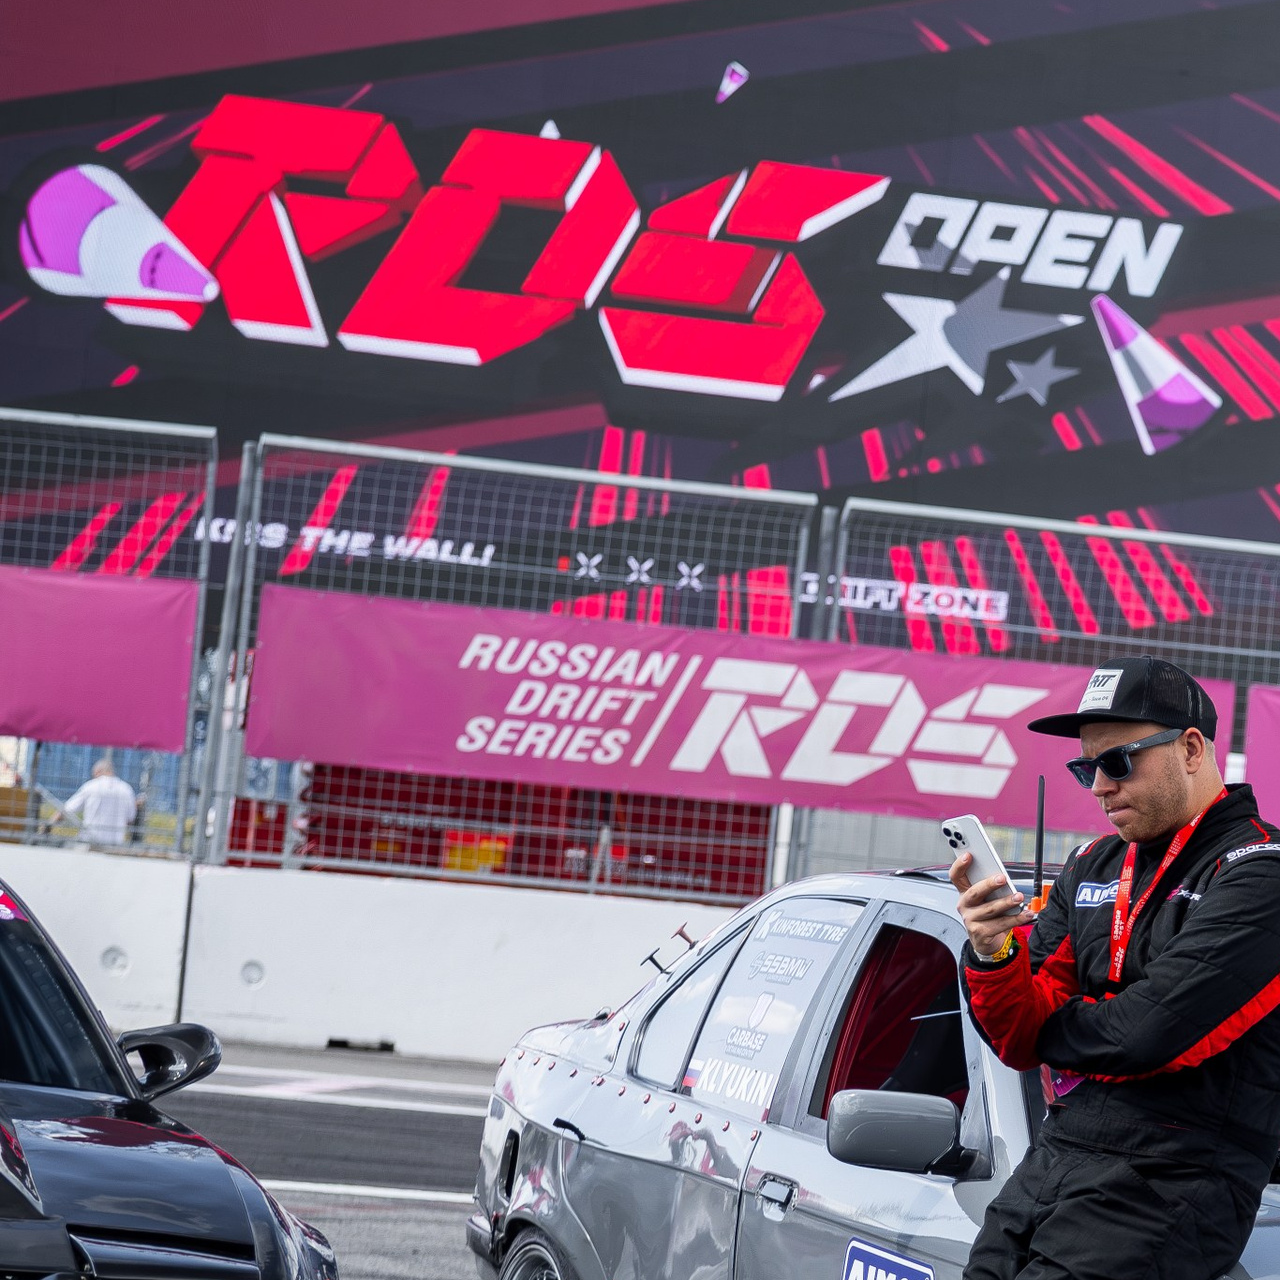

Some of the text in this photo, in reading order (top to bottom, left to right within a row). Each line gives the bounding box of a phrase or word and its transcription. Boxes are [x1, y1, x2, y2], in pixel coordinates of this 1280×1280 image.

[104, 94, 891, 401] RDS
[877, 192, 1184, 297] OPEN
[299, 526, 375, 557] THE
[907, 582, 1009, 621] ZONE
[458, 632, 680, 687] RUSSIAN
[504, 679, 658, 725] DRIFT
[455, 715, 632, 765] SERIES
[669, 657, 1051, 800] RDS
[817, 924, 848, 942] TYRE
[761, 954, 814, 979] SSBMW
[727, 1027, 766, 1051] CARBASE
[697, 1058, 774, 1107] KLYUKIN
